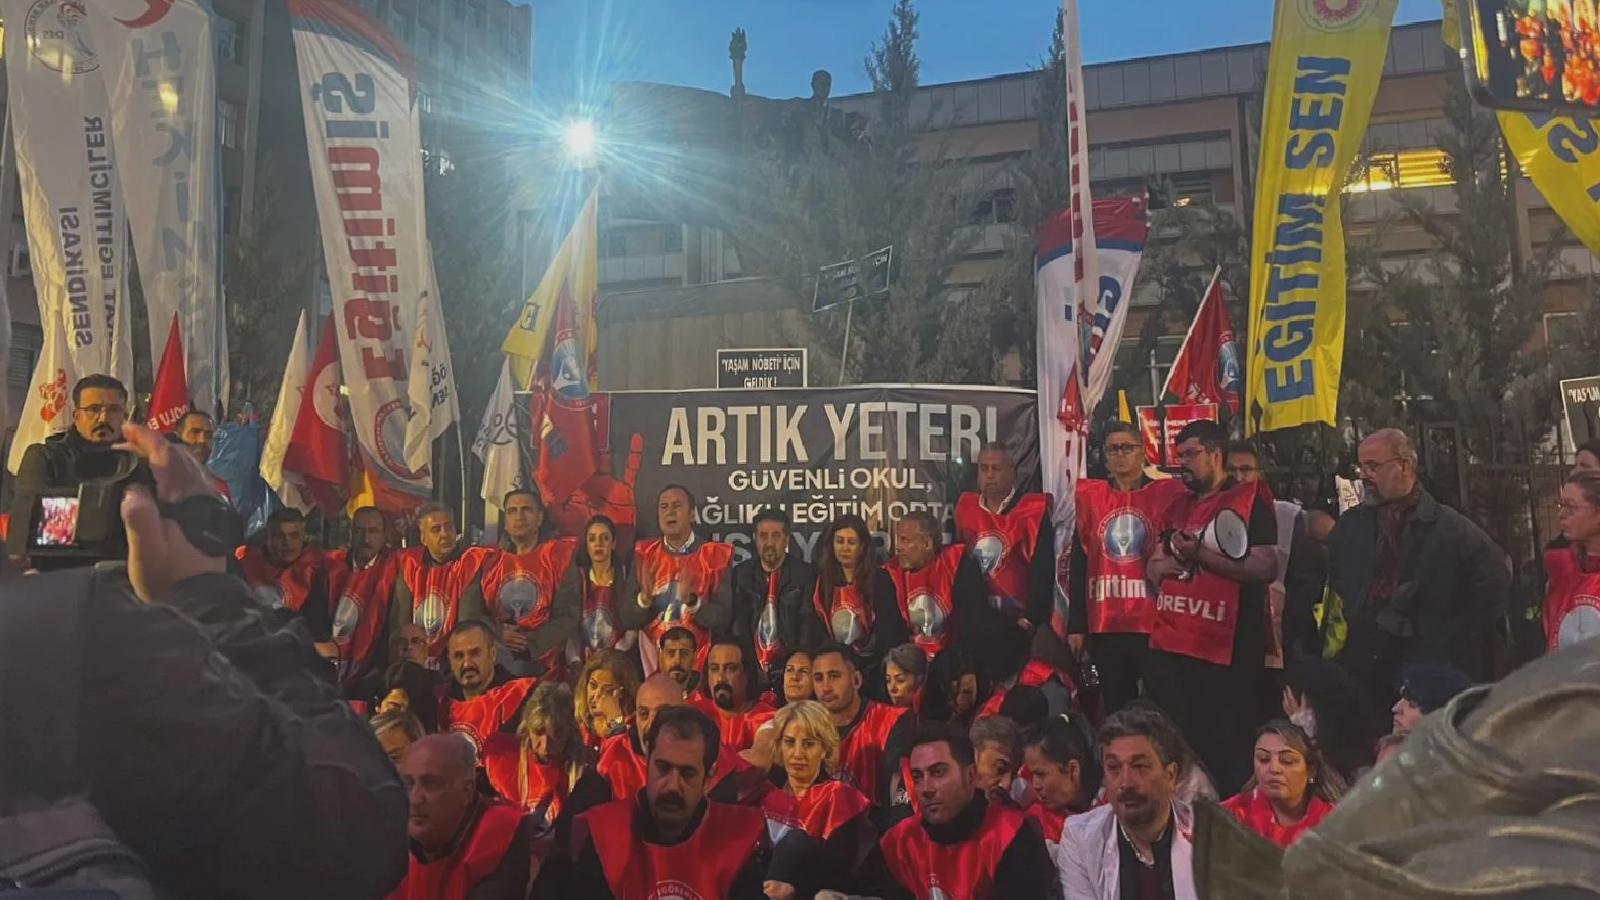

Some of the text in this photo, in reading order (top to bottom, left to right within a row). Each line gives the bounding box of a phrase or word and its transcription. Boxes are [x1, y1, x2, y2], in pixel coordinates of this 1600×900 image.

[1285, 55, 1351, 170] SEN
[661, 405, 808, 465] ARTIK
[824, 402, 997, 464] YETER!
[850, 467, 936, 493] OKUL,
[793, 494, 883, 524] EĞİTİM
